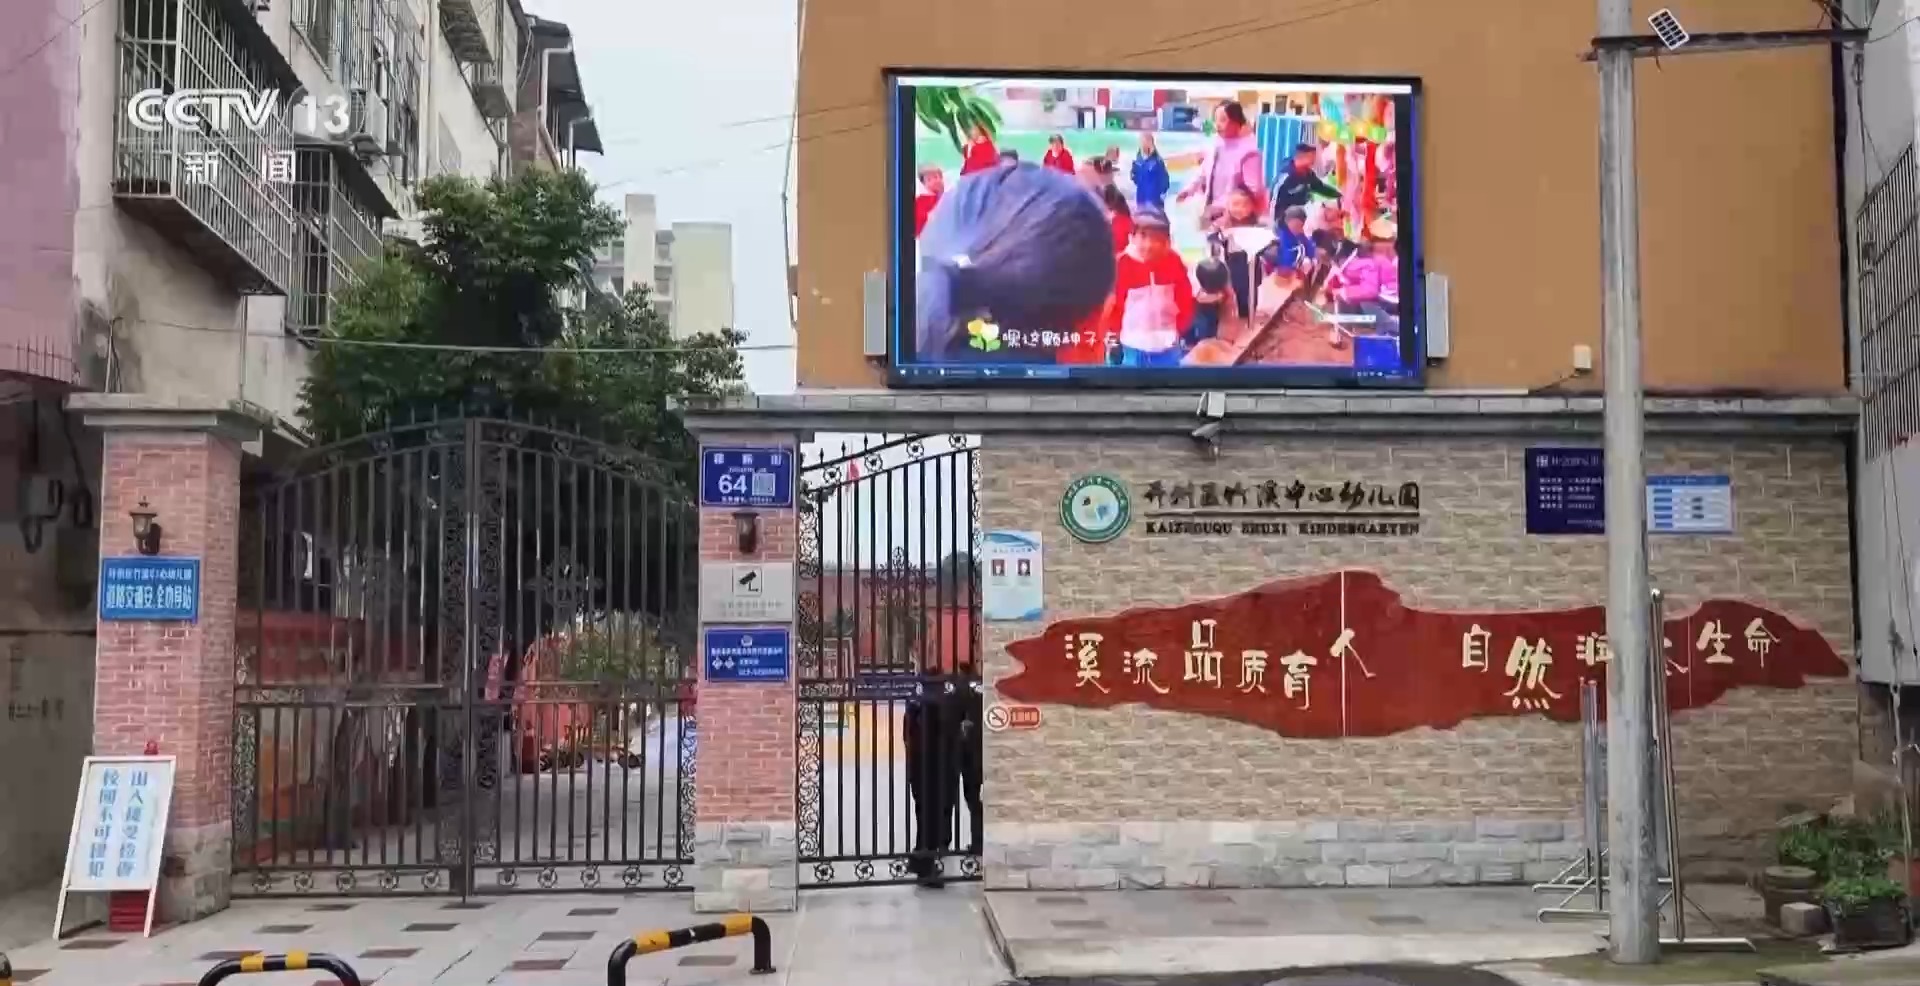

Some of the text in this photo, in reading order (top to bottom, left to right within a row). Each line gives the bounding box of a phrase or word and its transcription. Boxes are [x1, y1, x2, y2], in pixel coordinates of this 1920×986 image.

[718, 473, 748, 494] 64
[1064, 618, 1377, 711] 溪流品质育人
